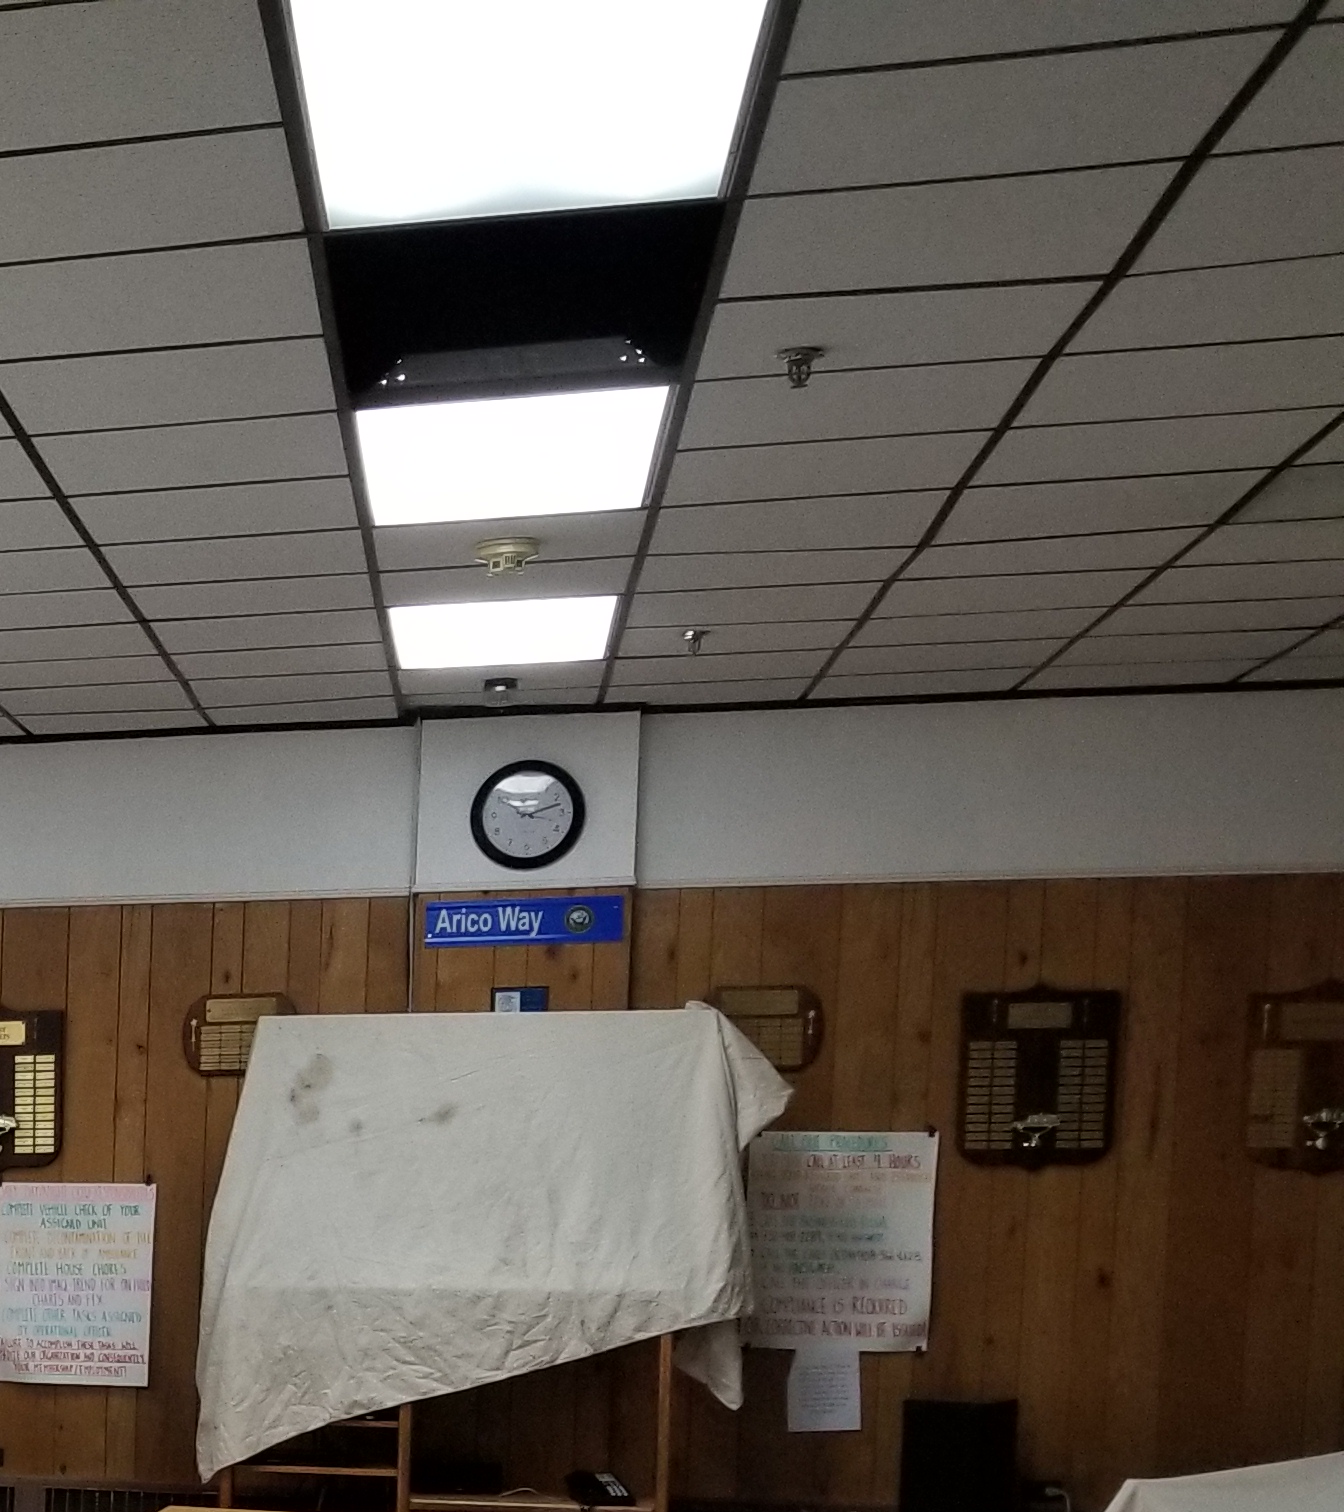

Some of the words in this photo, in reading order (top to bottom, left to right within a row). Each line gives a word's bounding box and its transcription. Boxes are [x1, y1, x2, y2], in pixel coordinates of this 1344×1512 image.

[435, 908, 493, 935] Arico
[498, 905, 544, 938] Way
[889, 1154, 921, 1169] HOURS
[74, 1204, 98, 1216] CHECK
[102, 1203, 113, 1216] OF
[119, 1204, 141, 1216] YOUR
[7, 1261, 49, 1276] COMPLETE
[56, 1262, 84, 1276] HOUSE
[92, 1262, 128, 1276] CHORES
[100, 1278, 116, 1291] FOR
[32, 1293, 64, 1306] CHARTS
[67, 1294, 82, 1306] AND
[85, 1294, 103, 1306] FIX
[852, 1296, 908, 1316] REQUIRED
[25, 1337, 34, 1348] TO
[36, 1338, 73, 1349] ACCOMPLISH
[23, 1351, 37, 1361] OUR
[39, 1351, 81, 1362] ORGANIZATION
